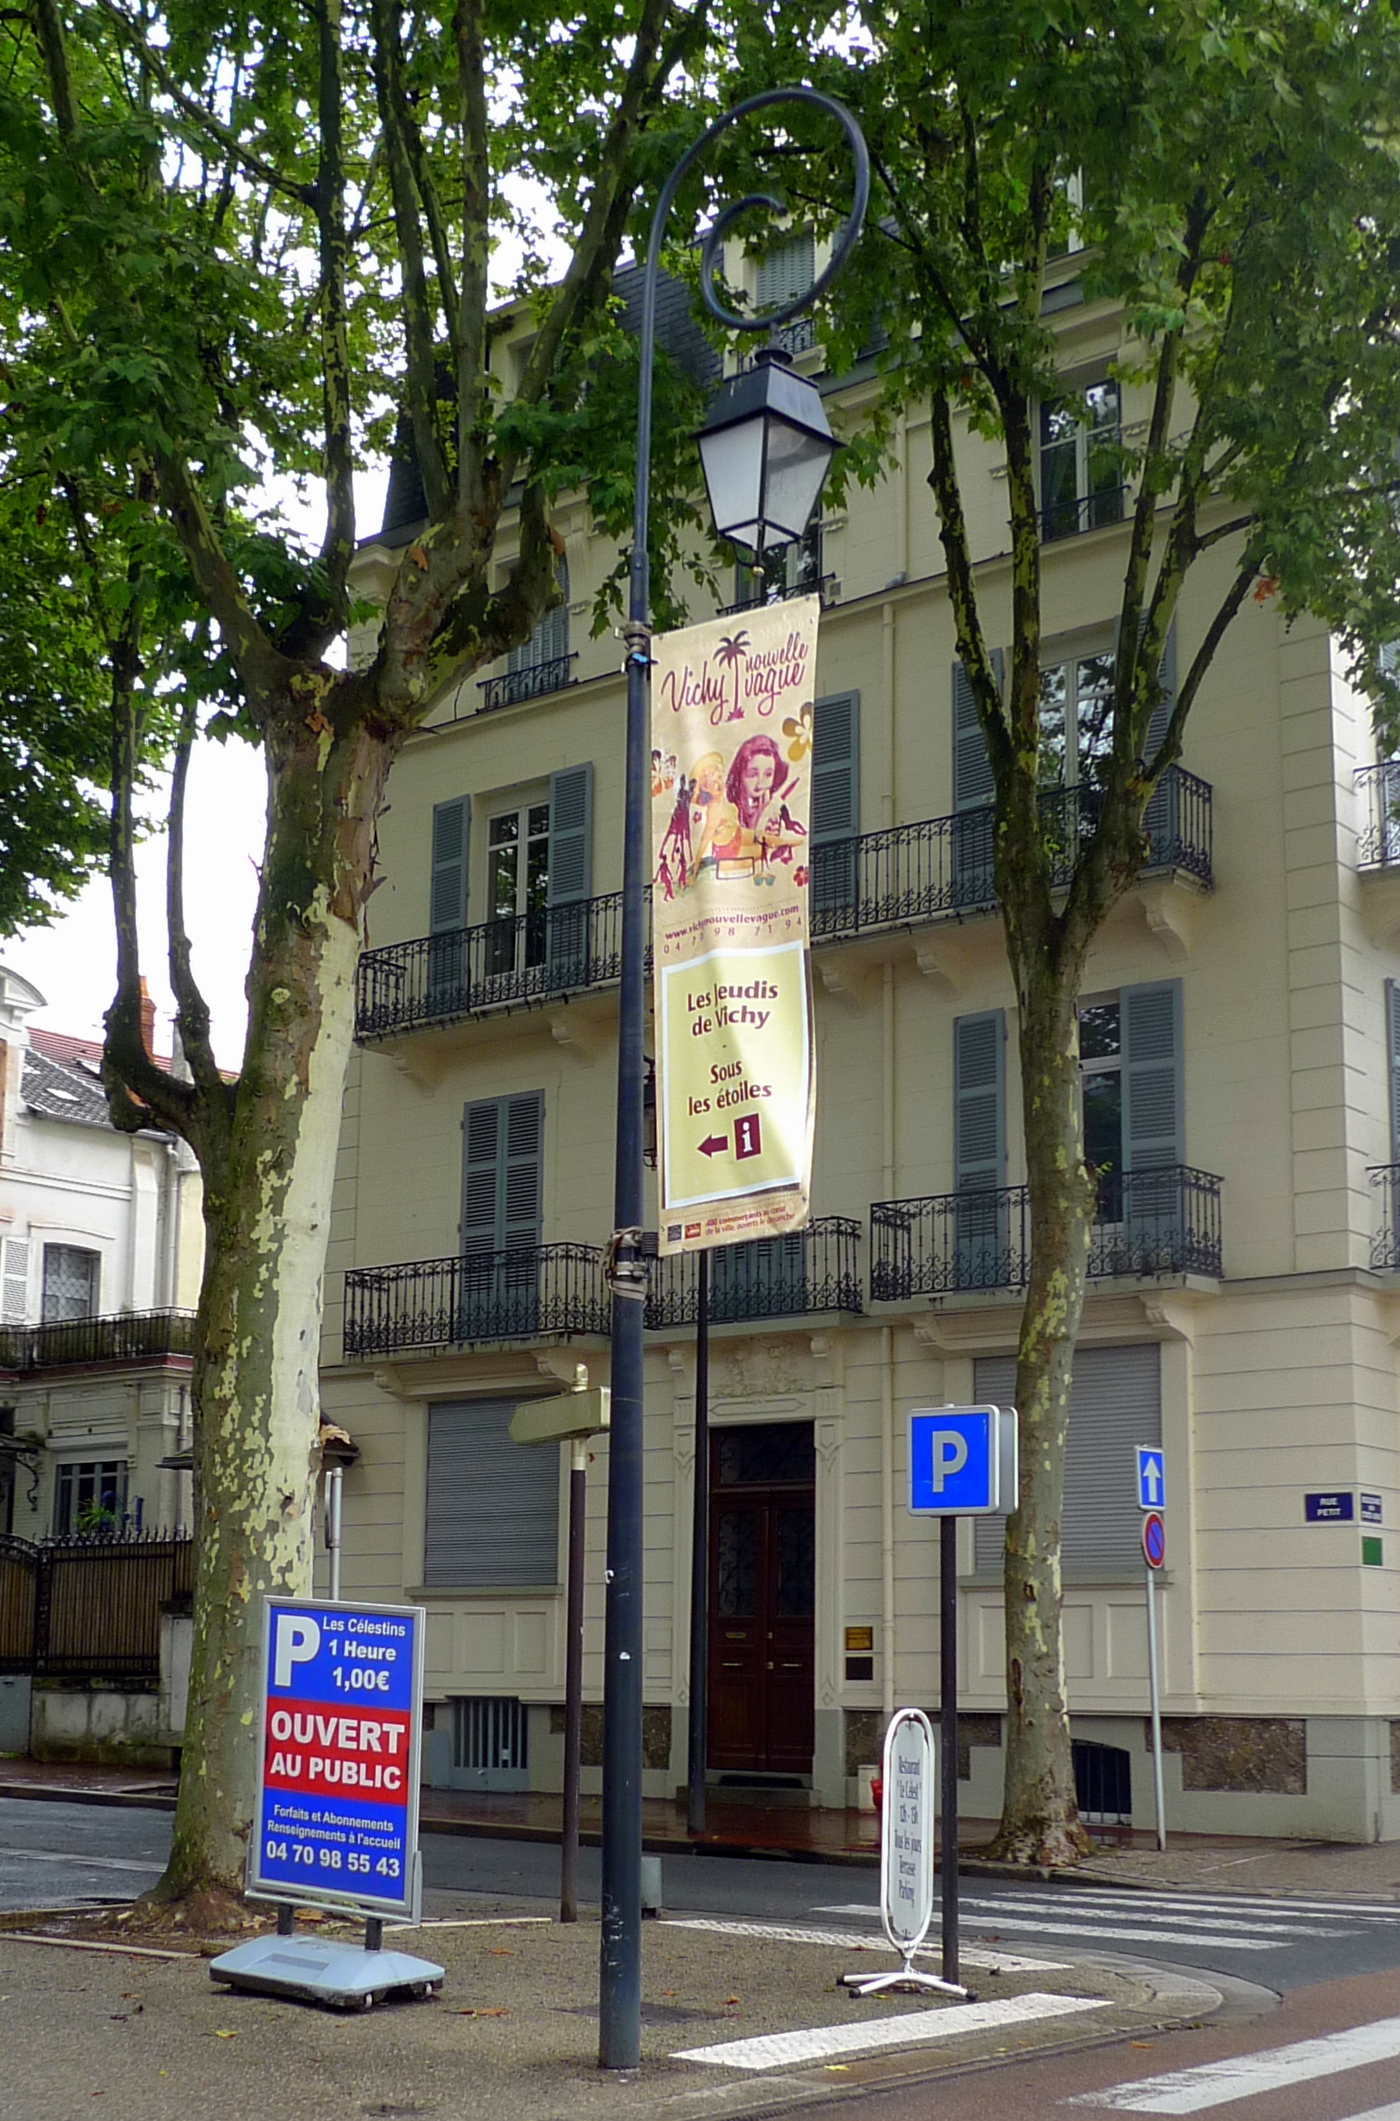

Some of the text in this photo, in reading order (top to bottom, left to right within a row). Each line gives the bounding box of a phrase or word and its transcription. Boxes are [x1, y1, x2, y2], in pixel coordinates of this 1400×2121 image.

[745, 631, 809, 673] nouvelle
[661, 660, 729, 726] Vichy
[744, 662, 805, 717] vague
[687, 980, 779, 1013] Les Jeudis
[692, 1005, 771, 1037] de Vichy
[709, 1060, 743, 1085] Sous
[688, 1080, 772, 1117] les étoiles
[932, 1430, 968, 1493] P
[274, 1614, 406, 1687] P Les Célestins
[329, 1639, 397, 1661] 1 Heure
[332, 1666, 390, 1692] 1,00€
[271, 1710, 406, 1754] OUVERT
[269, 1752, 402, 1790] AU PUBLIC
[899, 1755, 920, 1775] Restaurant
[267, 1819, 401, 1850] Renseignements à l'accueil
[274, 1804, 394, 1832] Forfaits et Abonnements
[894, 1828, 903, 1849] Tous
[266, 1840, 400, 1877] 04 70 98 55 43
[899, 1879, 915, 1909] Parking
